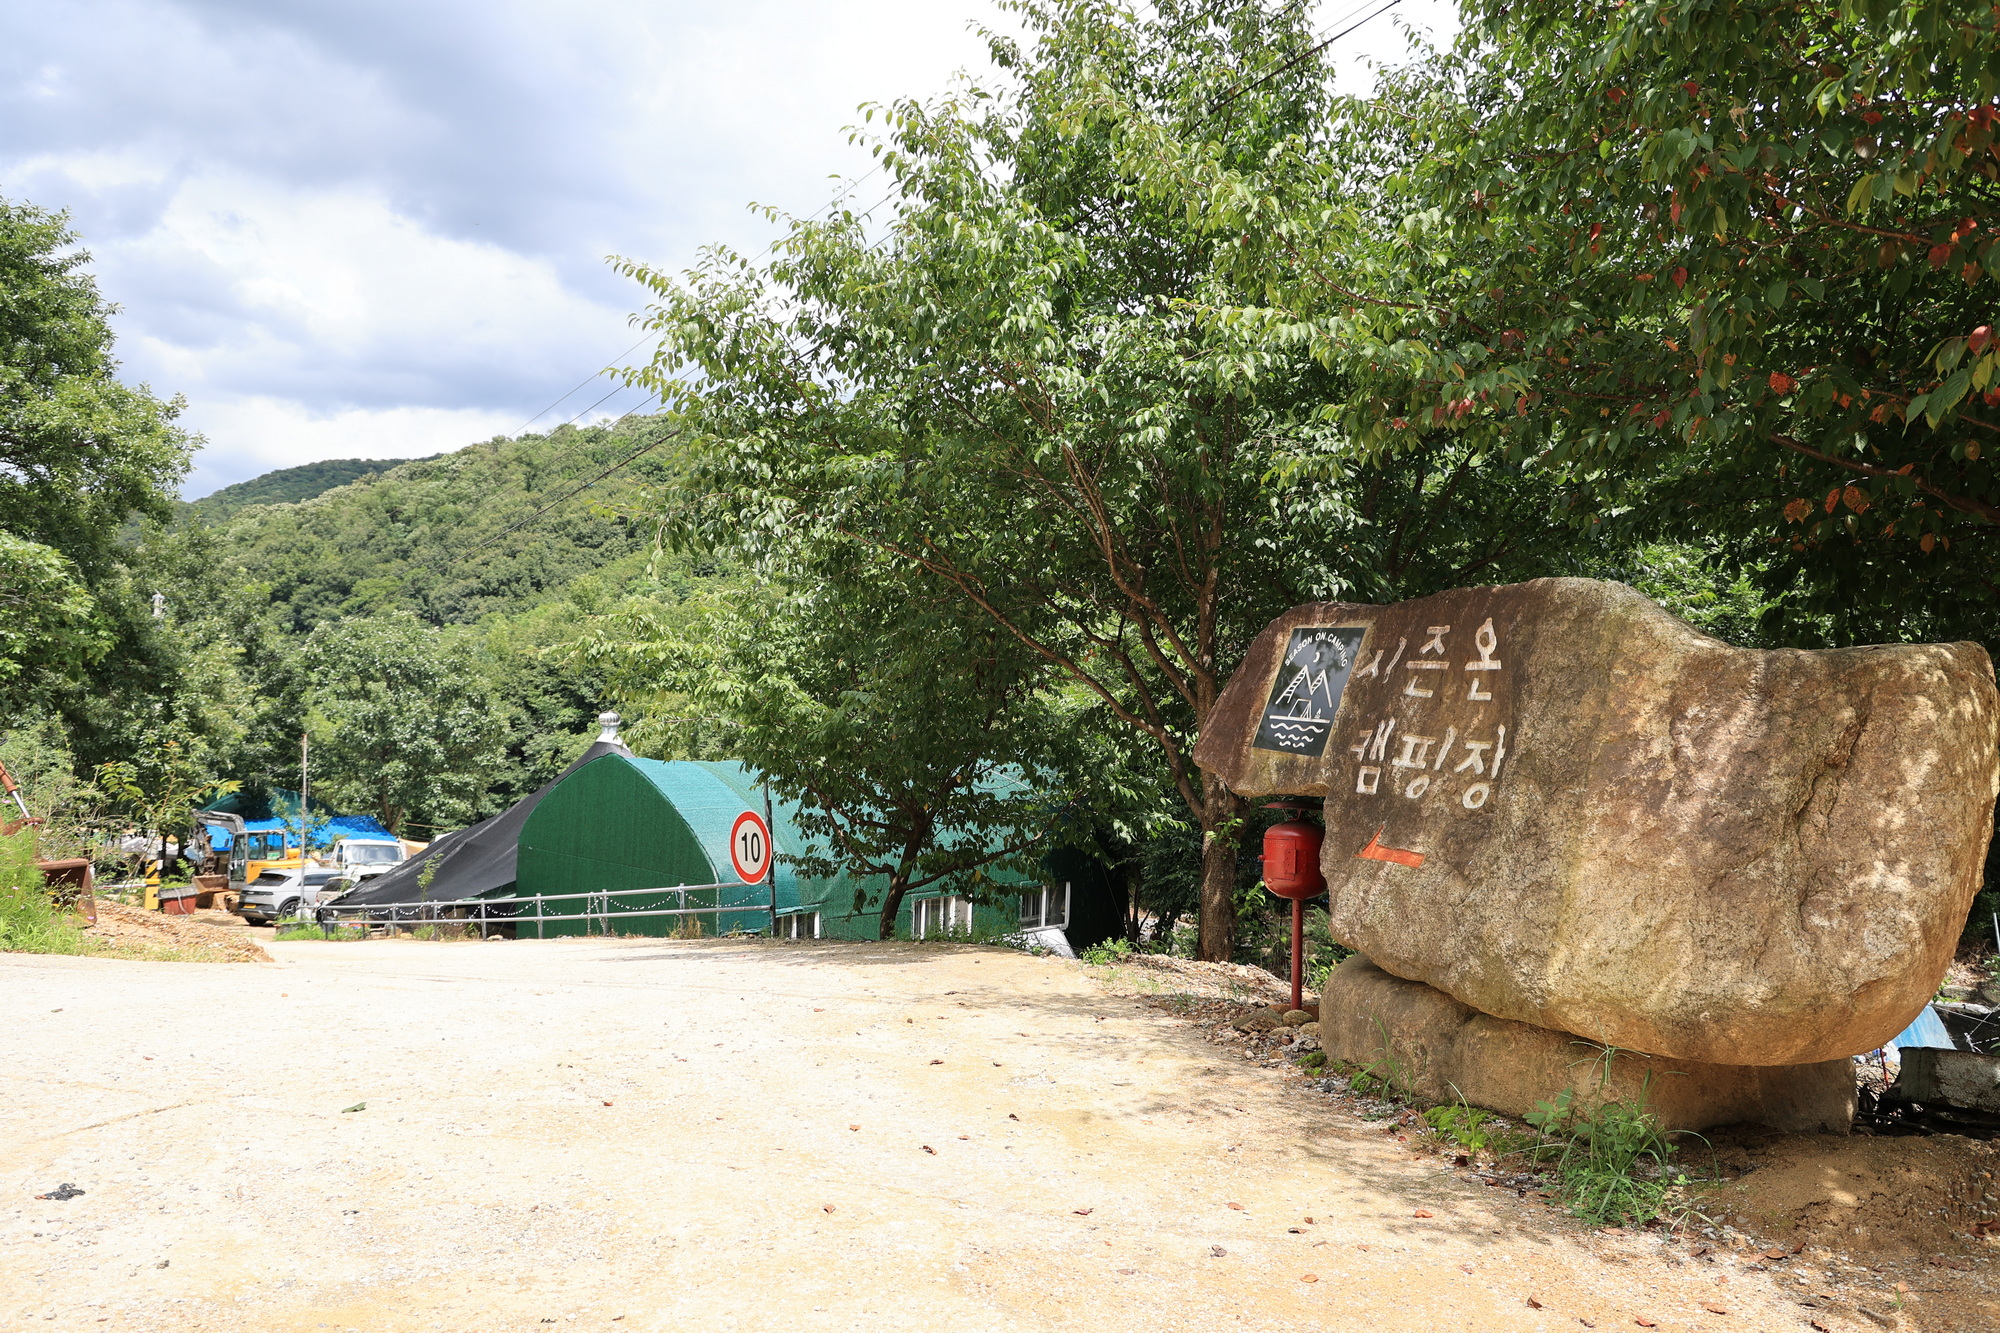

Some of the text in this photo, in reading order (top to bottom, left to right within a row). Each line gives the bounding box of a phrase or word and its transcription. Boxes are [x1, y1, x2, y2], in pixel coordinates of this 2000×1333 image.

[1284, 631, 1348, 668] SEASON ON CAMPING
[1356, 617, 1502, 701] 시즌온
[1350, 716, 1506, 809] 캠핑장
[741, 832, 760, 863] 10
